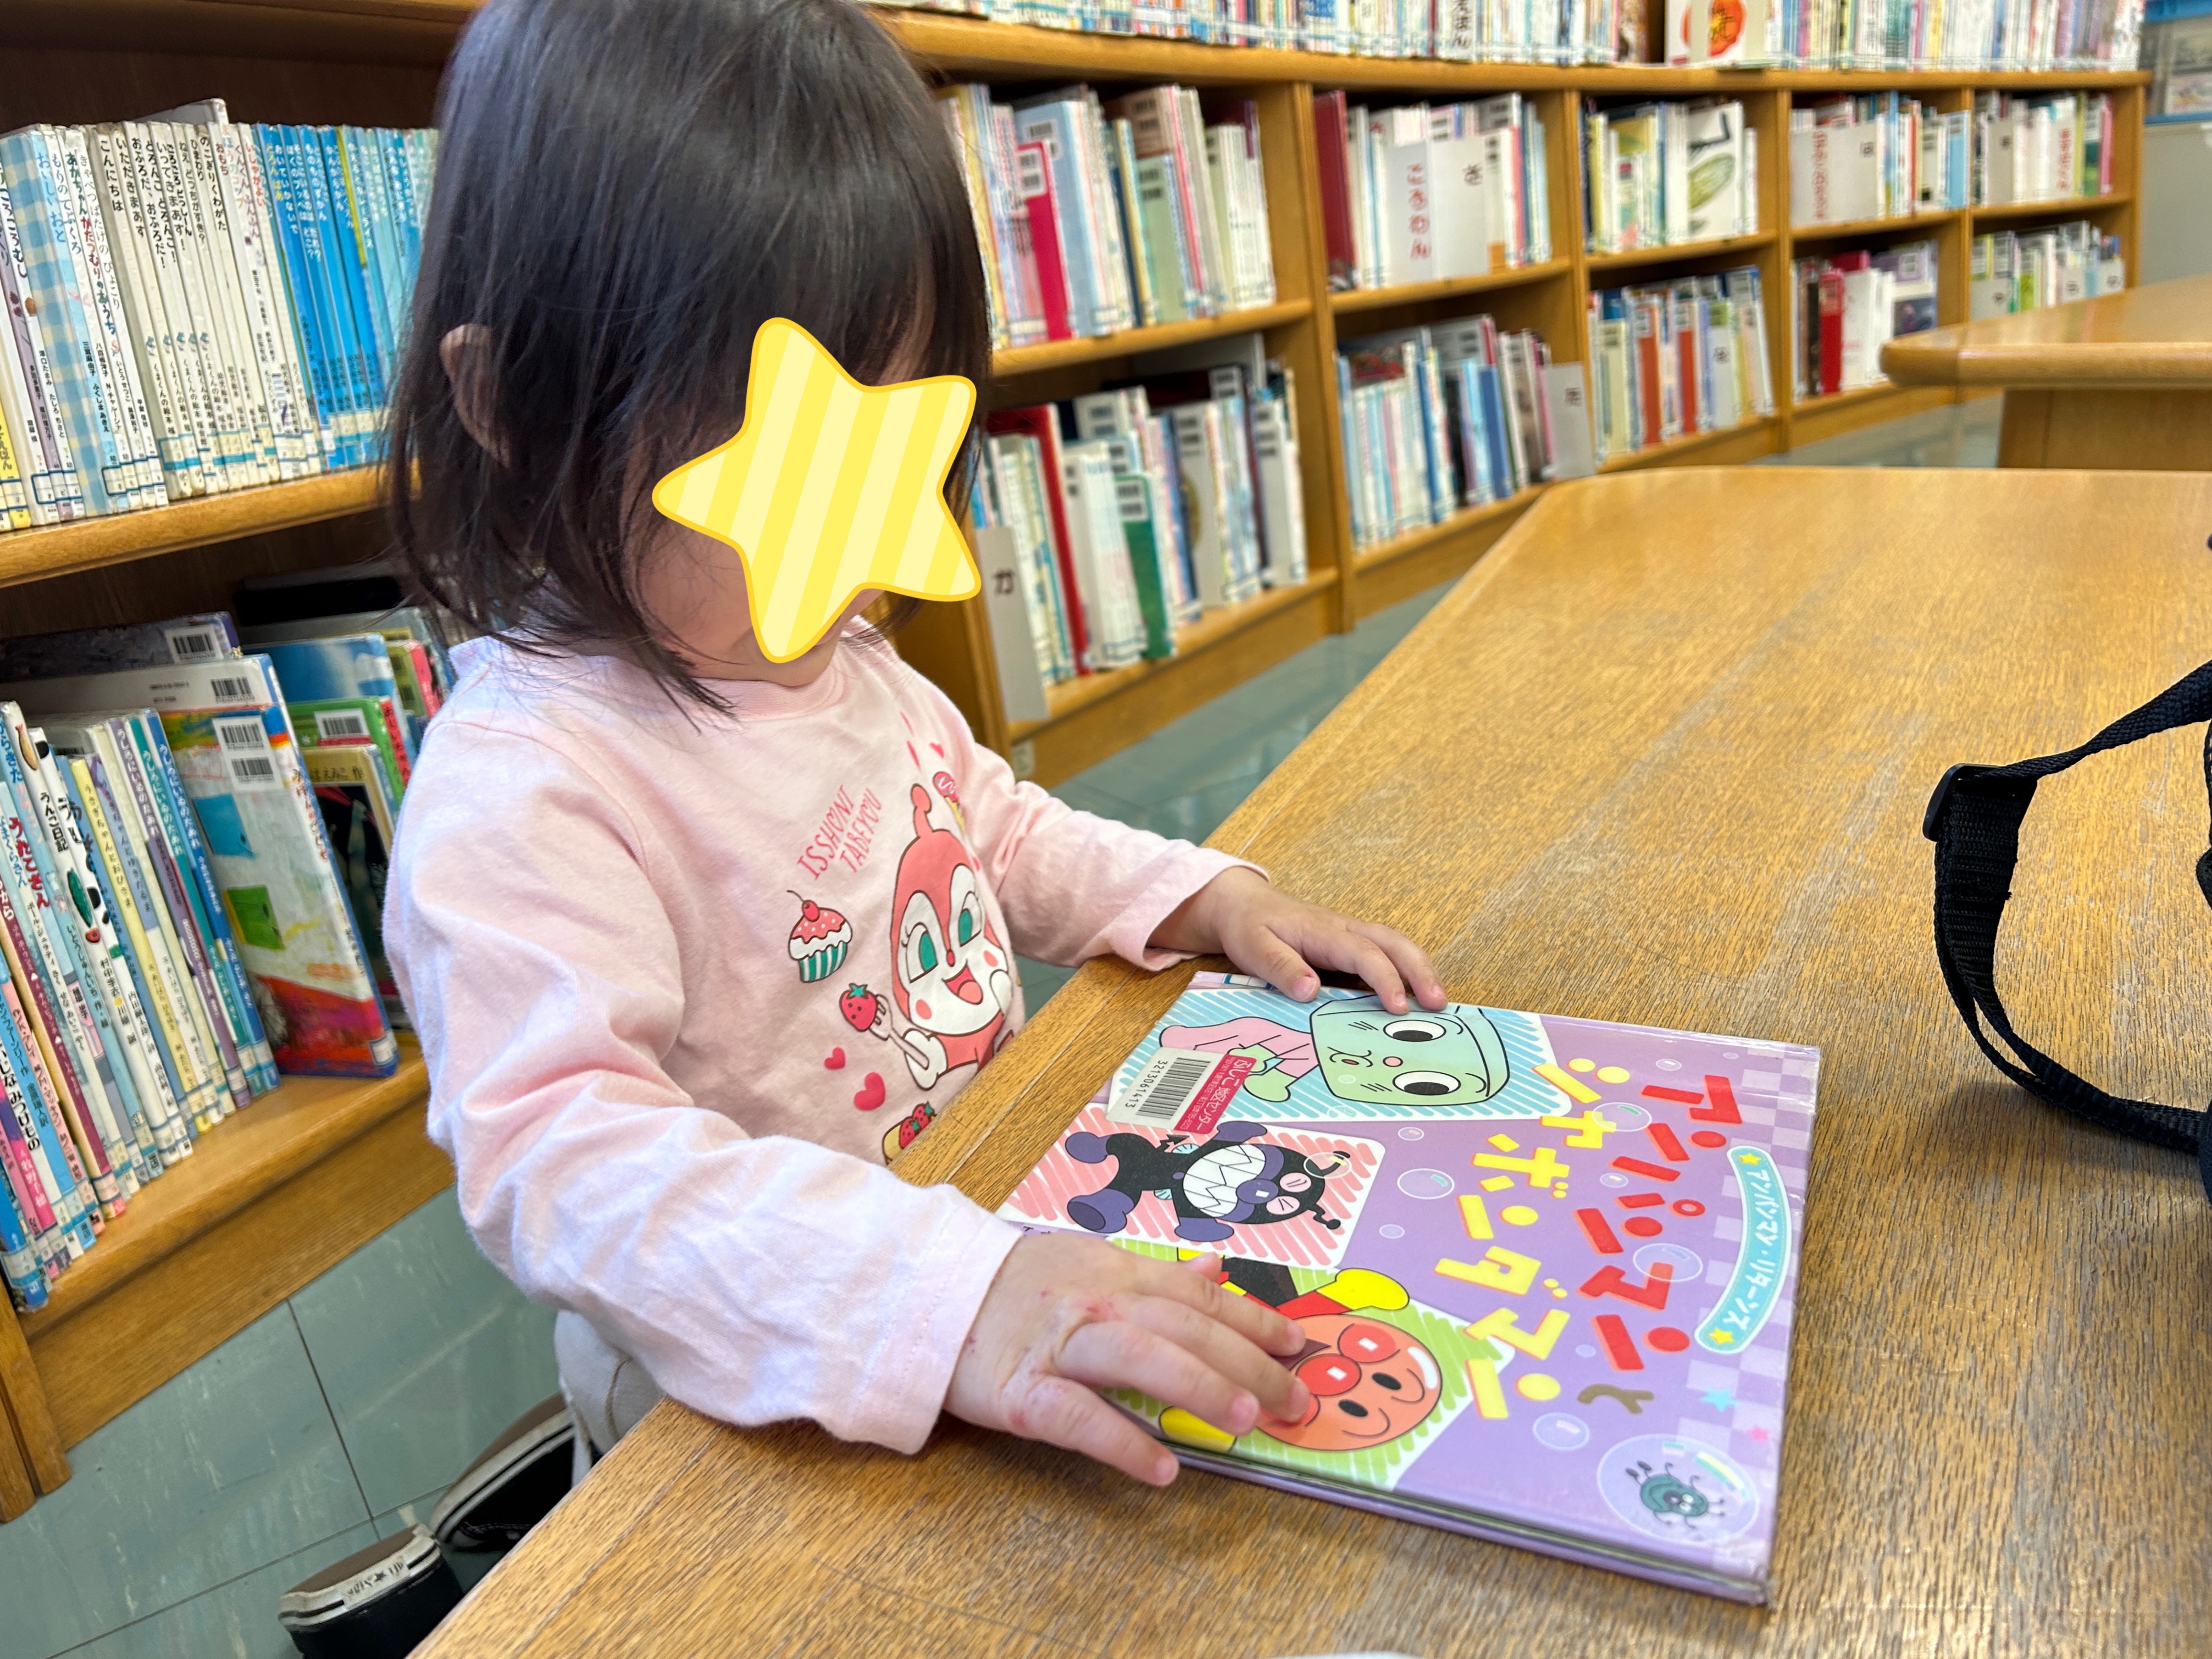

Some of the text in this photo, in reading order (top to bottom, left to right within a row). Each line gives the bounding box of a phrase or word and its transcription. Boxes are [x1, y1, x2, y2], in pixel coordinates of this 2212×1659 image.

[100, 140, 124, 211] こんにちは
[116, 137, 145, 237] いただきまあす
[190, 138, 204, 181] ひまわり
[201, 137, 227, 232] のこぎりくわがた
[215, 143, 229, 176] おもち
[153, 363, 172, 424] くまくんの絵本
[41, 792, 69, 852] うんこ日記
[84, 783, 132, 908] うさぎちゃんとおひさま
[797, 784, 855, 880] ISSHONI
[840, 787, 883, 873] TABEYOU
[9, 1089, 40, 1152] みつけもの
[1124, 1059, 1168, 1109] 3213061413
[1433, 1057, 1631, 1419] シャボンダマン
[1573, 1074, 1743, 1372] アンパンマン
[1722, 1168, 1779, 1330] アンパンマン・リターンズ
[1576, 1382, 1655, 1416] と
